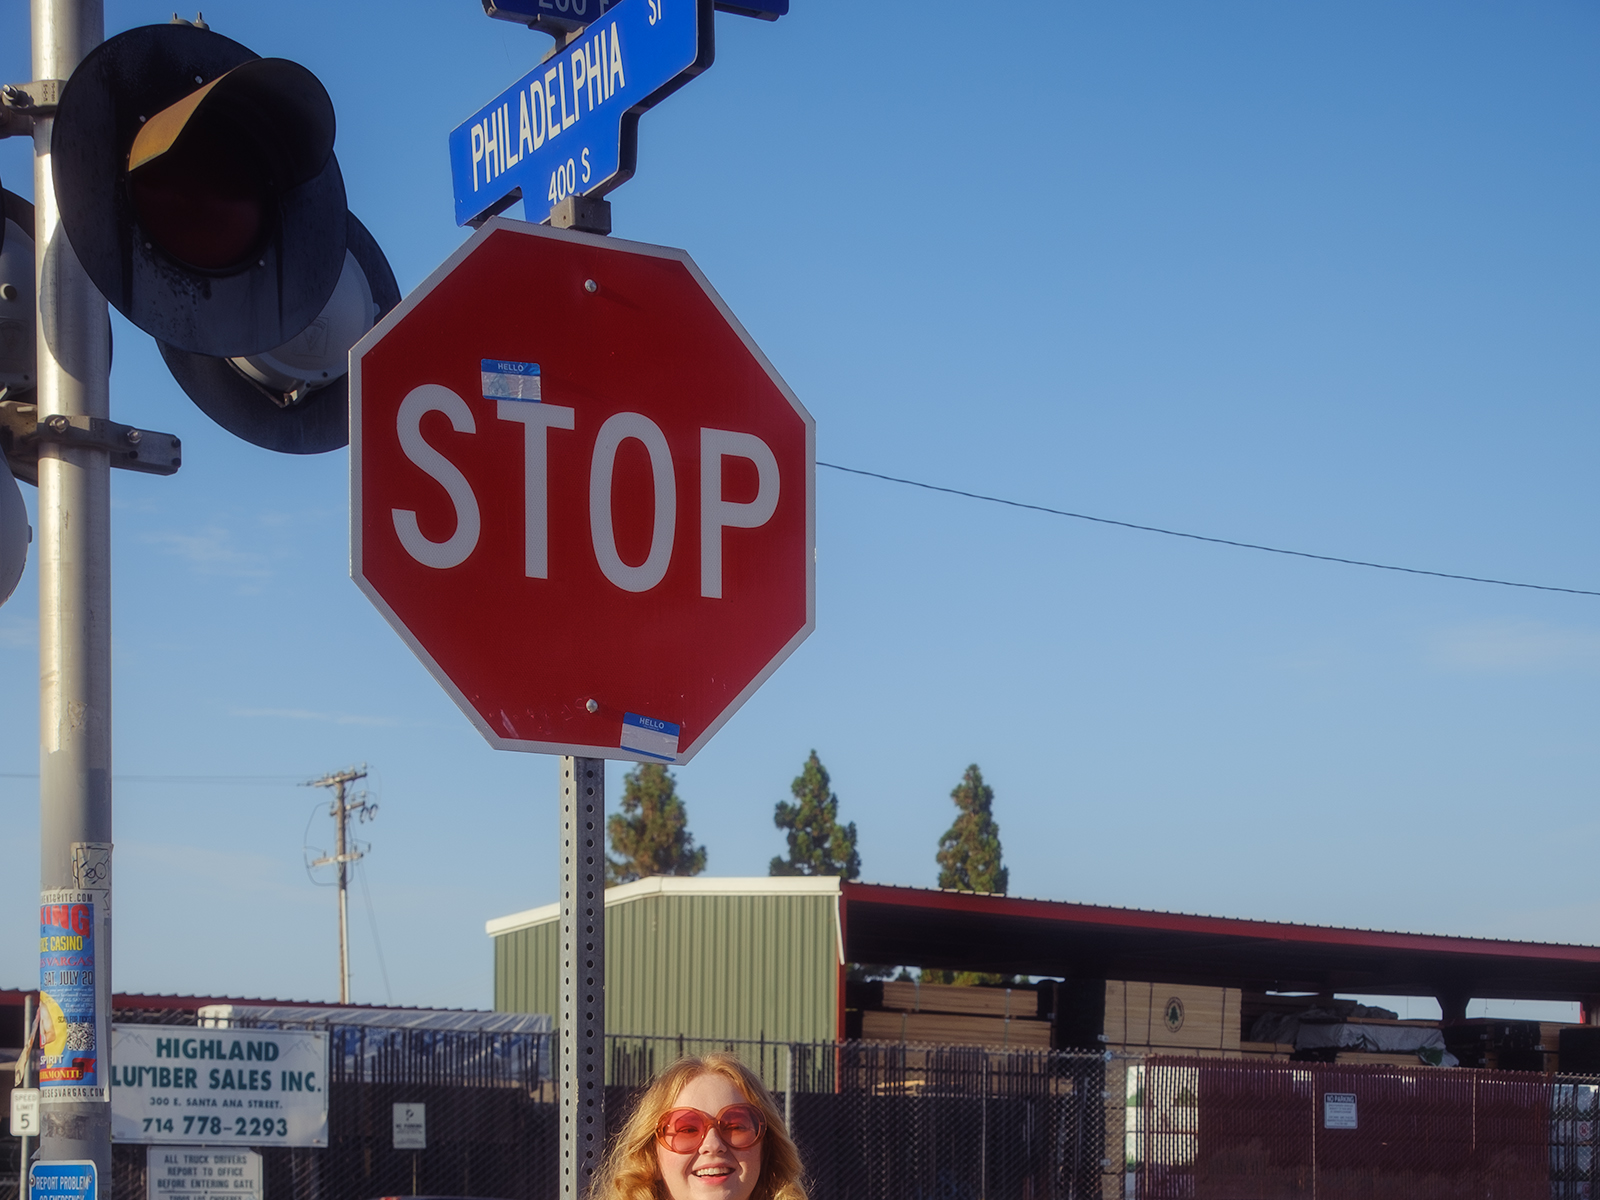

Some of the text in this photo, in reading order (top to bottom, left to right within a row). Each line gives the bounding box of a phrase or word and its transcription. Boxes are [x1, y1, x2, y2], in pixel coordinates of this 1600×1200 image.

[471, 21, 625, 192] PHILADELPHIA
[548, 147, 591, 205] 400 S
[497, 362, 524, 372] HELLO
[391, 383, 781, 600] STOP
[639, 717, 665, 730] HELLO
[50, 935, 83, 952] CASINO
[46, 955, 94, 967] VARGAS
[44, 970, 94, 987] SAT. JULY 20
[156, 1037, 279, 1062] HIGHLAND
[40, 1055, 63, 1065] SPIRIT
[111, 1065, 322, 1092] LUMBER SALES INC.
[14, 1093, 36, 1101] SPEED
[149, 1097, 283, 1109] 300 E. SANTA ANA STREET.
[16, 1103, 34, 1111] LIMIT
[20, 1113, 30, 1129] 5
[142, 1115, 288, 1137] 714 778-2293
[164, 1154, 247, 1164] ALL TRUCK DRIVERS
[167, 1167, 243, 1176] REPORT TO OFFICE
[35, 1176, 89, 1190] REPORT PROBLEM
[157, 1179, 253, 1189] BEFORE ENTERING GATE
